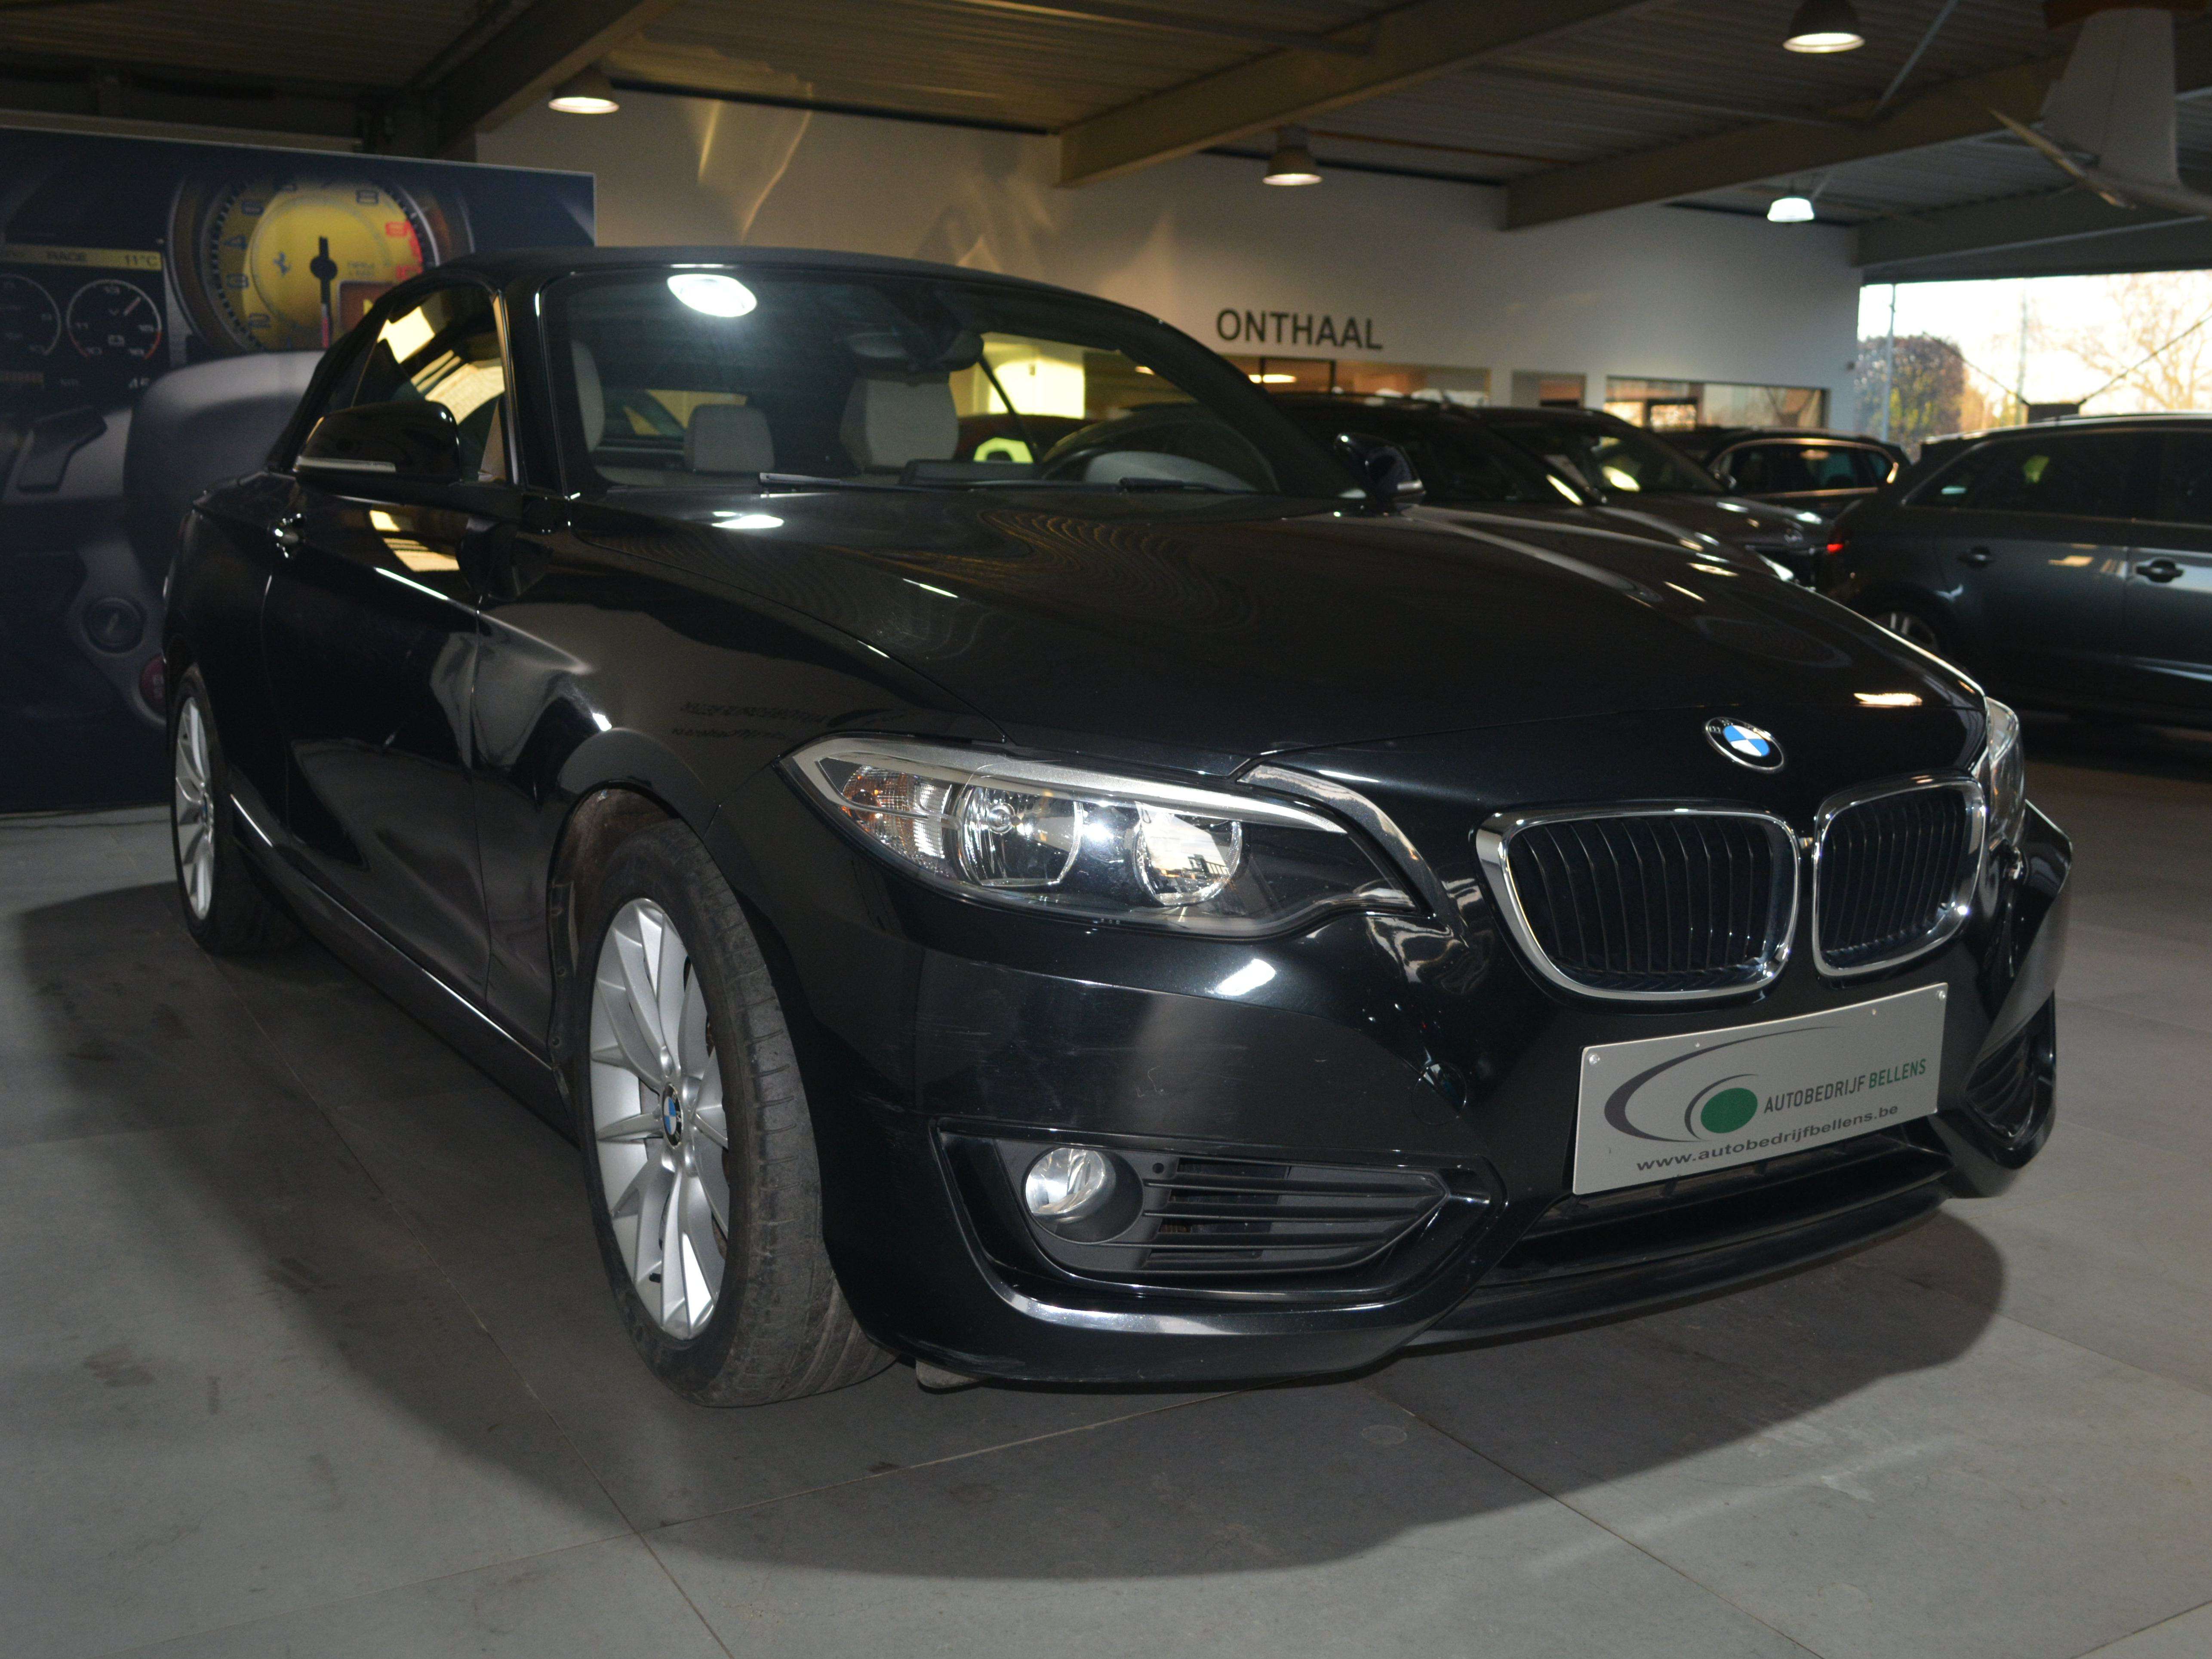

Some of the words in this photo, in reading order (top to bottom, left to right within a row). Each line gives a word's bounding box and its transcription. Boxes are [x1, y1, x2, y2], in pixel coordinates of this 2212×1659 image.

[1216, 308, 1383, 350] ONTHAAL
[1764, 1075, 1866, 1114] AUTOBEDRIJF
[1869, 1058, 1927, 1089] BELLENS
[1637, 1105, 1898, 1171] www.autobedrijfbellens.be
